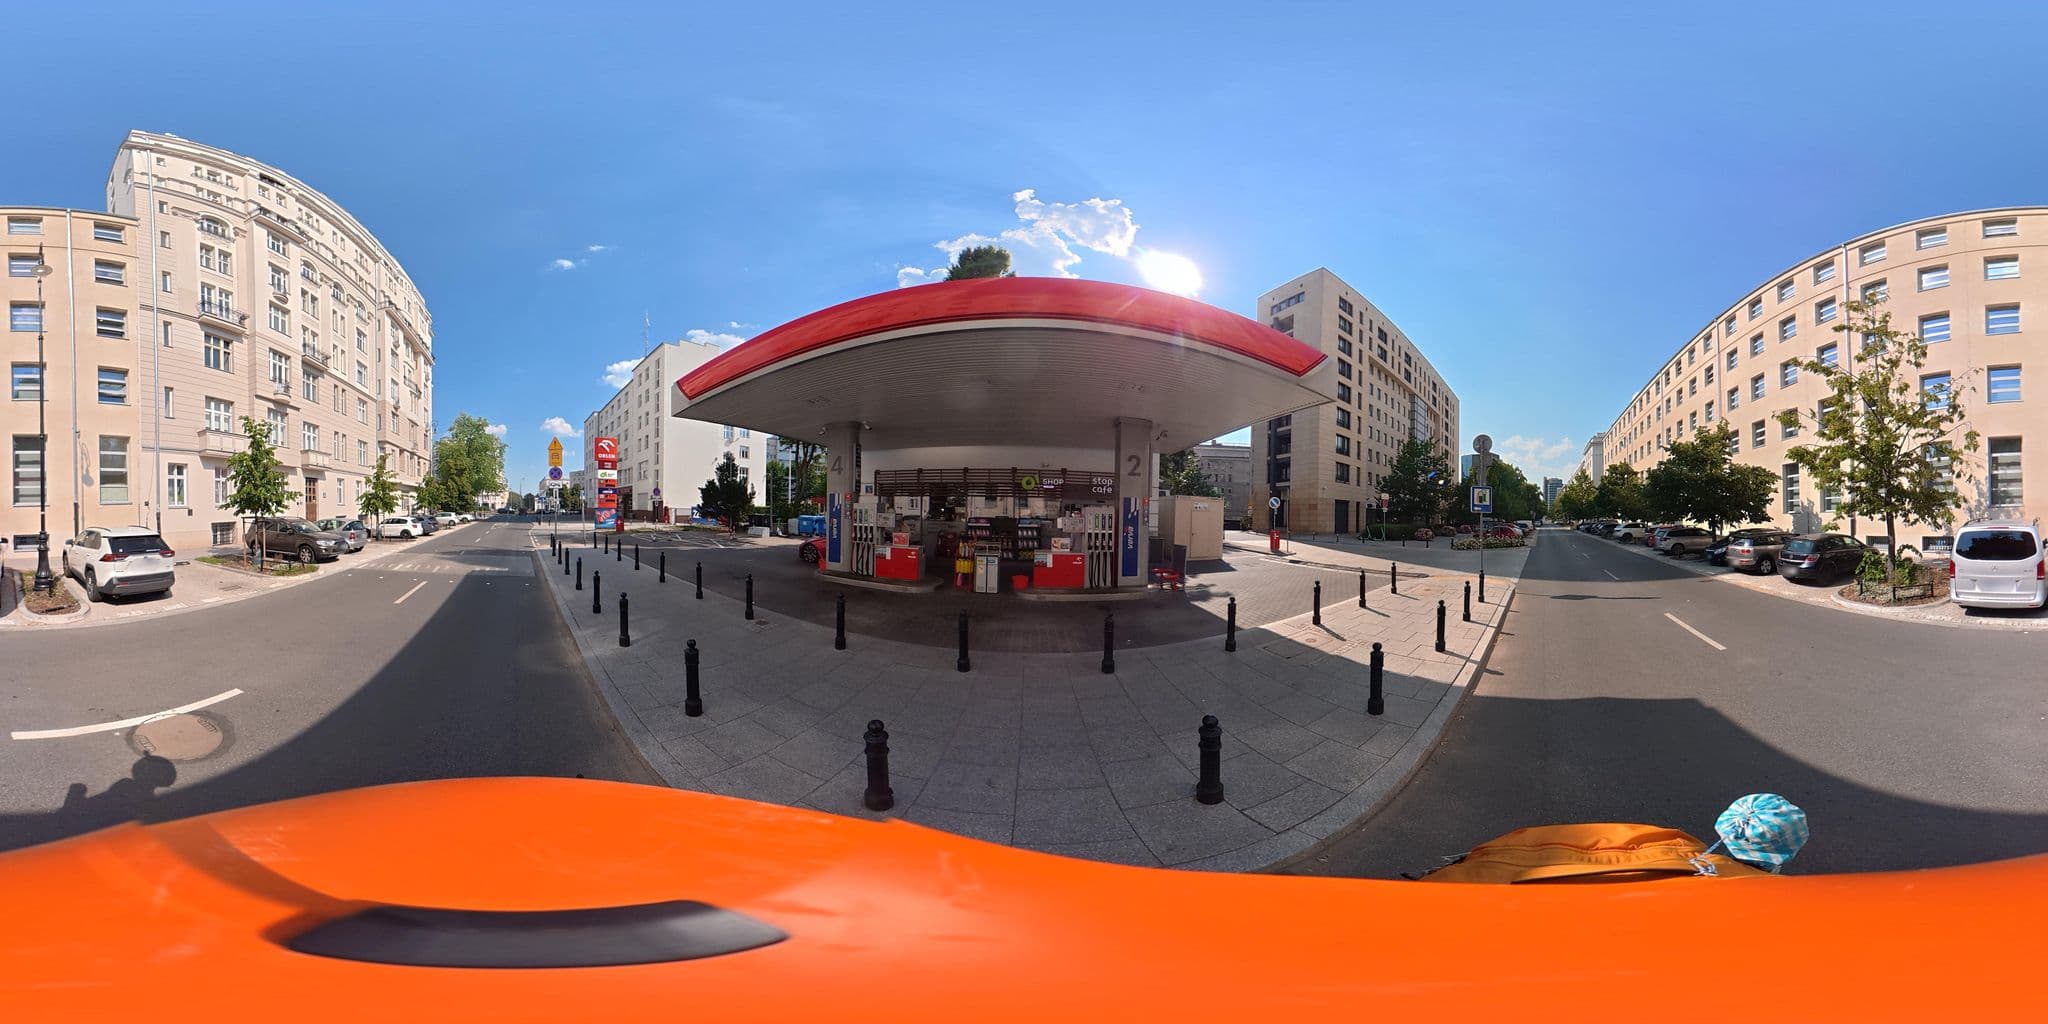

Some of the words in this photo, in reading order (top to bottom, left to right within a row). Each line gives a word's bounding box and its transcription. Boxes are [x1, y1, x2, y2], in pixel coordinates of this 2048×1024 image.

[831, 455, 844, 476] 4
[1127, 454, 1141, 477] 2
[1042, 478, 1065, 486] SHOP
[1092, 477, 1113, 486] stop
[1091, 485, 1113, 494] cafe
